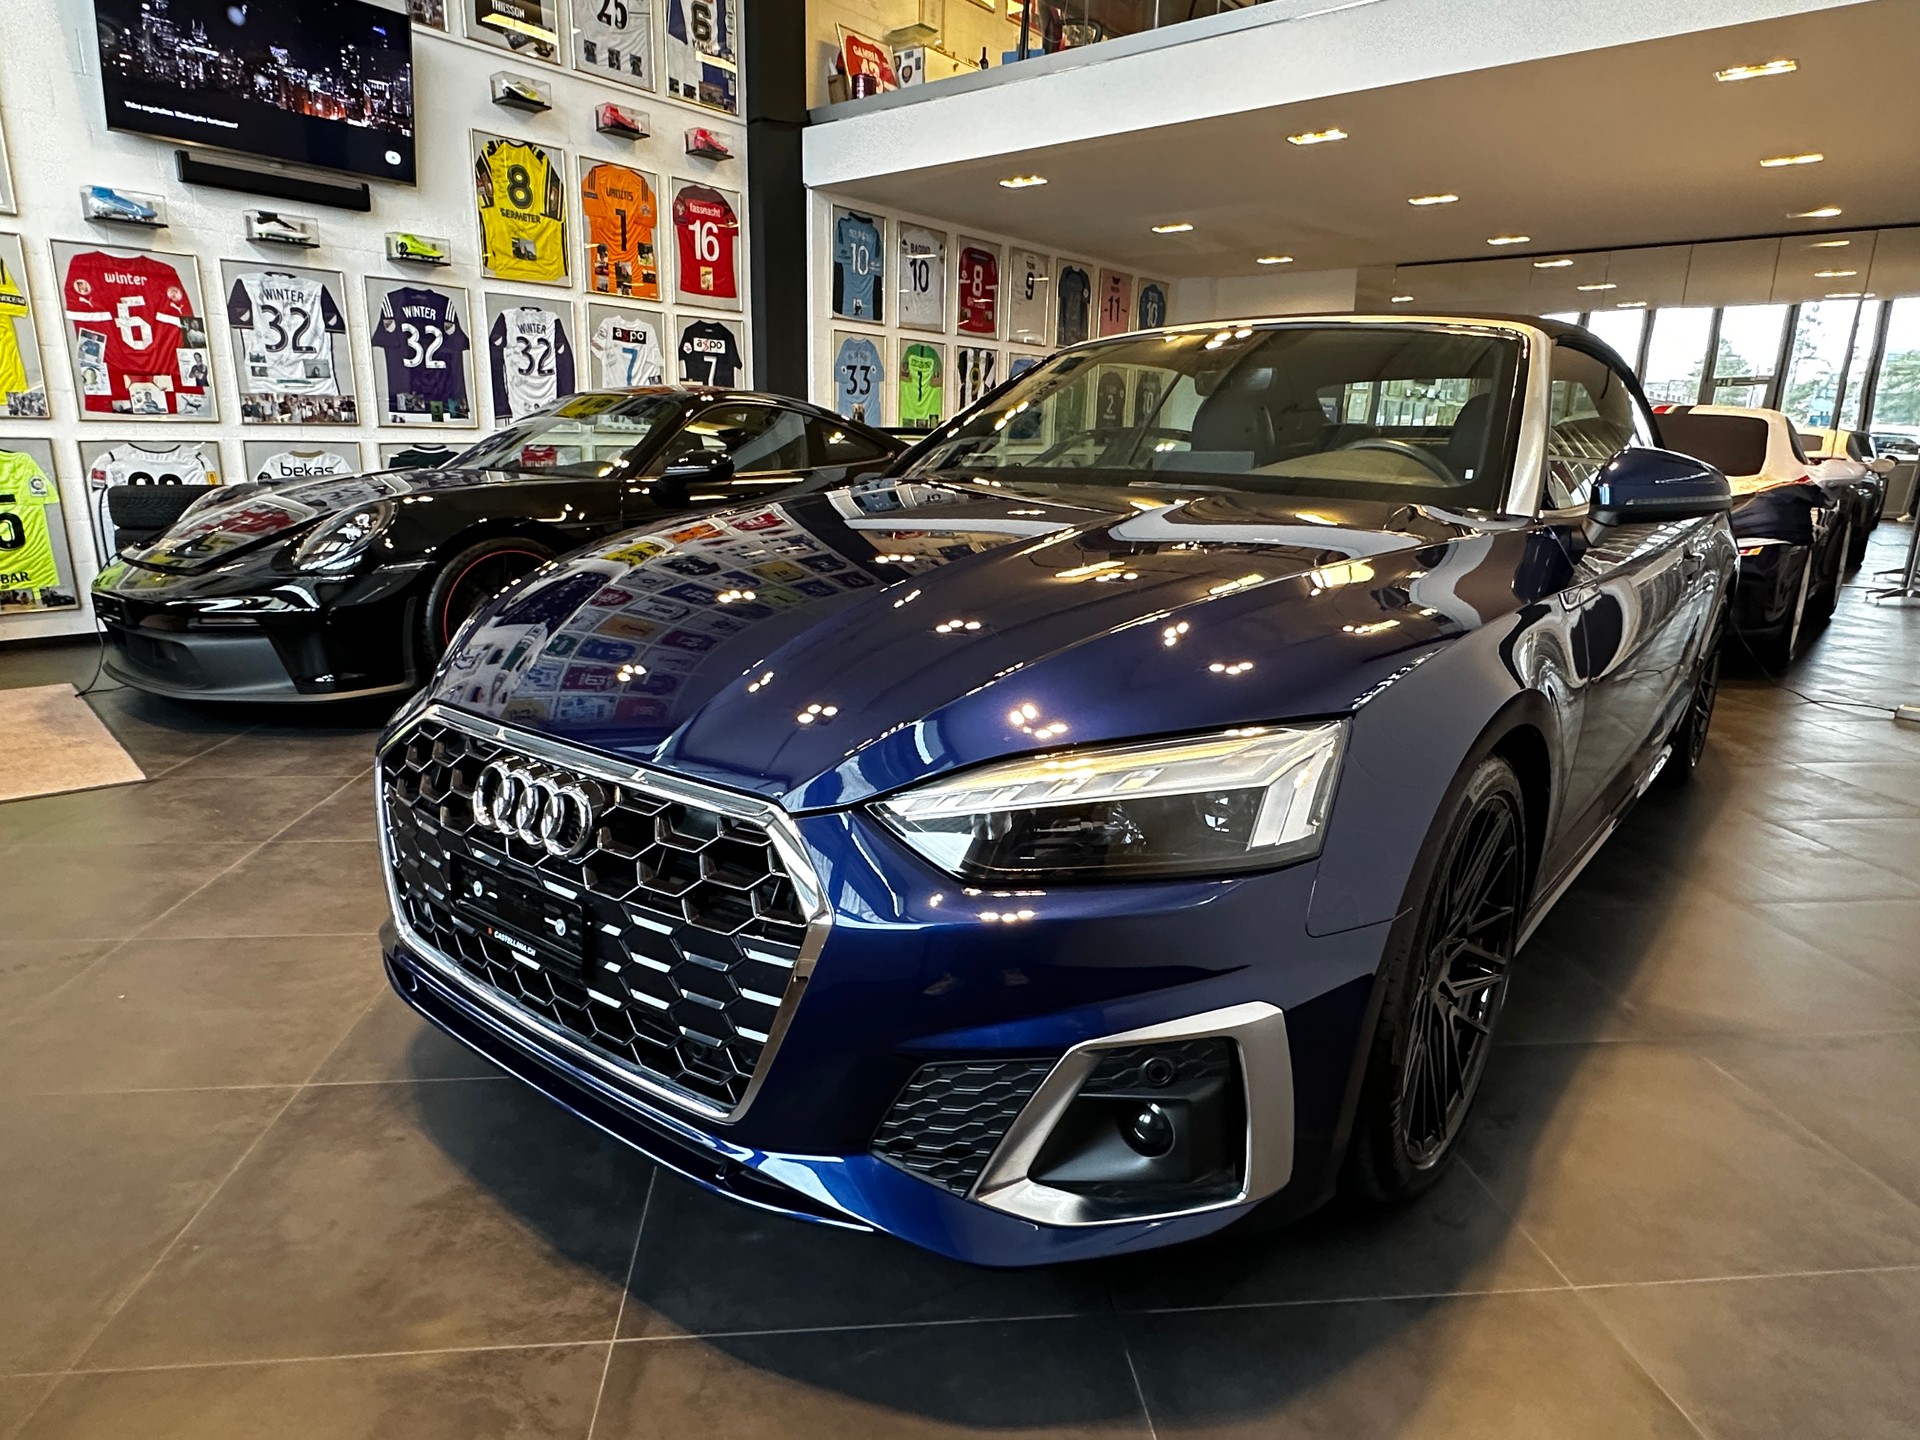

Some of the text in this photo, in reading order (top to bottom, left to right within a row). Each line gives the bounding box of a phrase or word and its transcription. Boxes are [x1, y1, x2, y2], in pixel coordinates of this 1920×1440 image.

[691, 1, 711, 41] 6
[507, 164, 533, 209] 8
[690, 203, 721, 218] fassnacht
[615, 209, 627, 251] 1
[689, 219, 720, 262] 16
[851, 243, 869, 276] 10
[910, 258, 929, 292] 10
[104, 272, 148, 286] winter
[263, 288, 304, 302] WINTER
[972, 265, 983, 297] 8
[1025, 272, 1034, 300] 9
[114, 295, 153, 350] 6
[402, 306, 437, 321] WINTER
[1108, 296, 1120, 322] 11
[261, 304, 317, 353] 32
[517, 323, 547, 335] WINTER
[401, 323, 447, 369] 32
[516, 336, 555, 376] 32
[622, 347, 638, 386] 7
[703, 356, 717, 386] 7
[846, 365, 870, 395] 33
[280, 462, 334, 477] bekas
